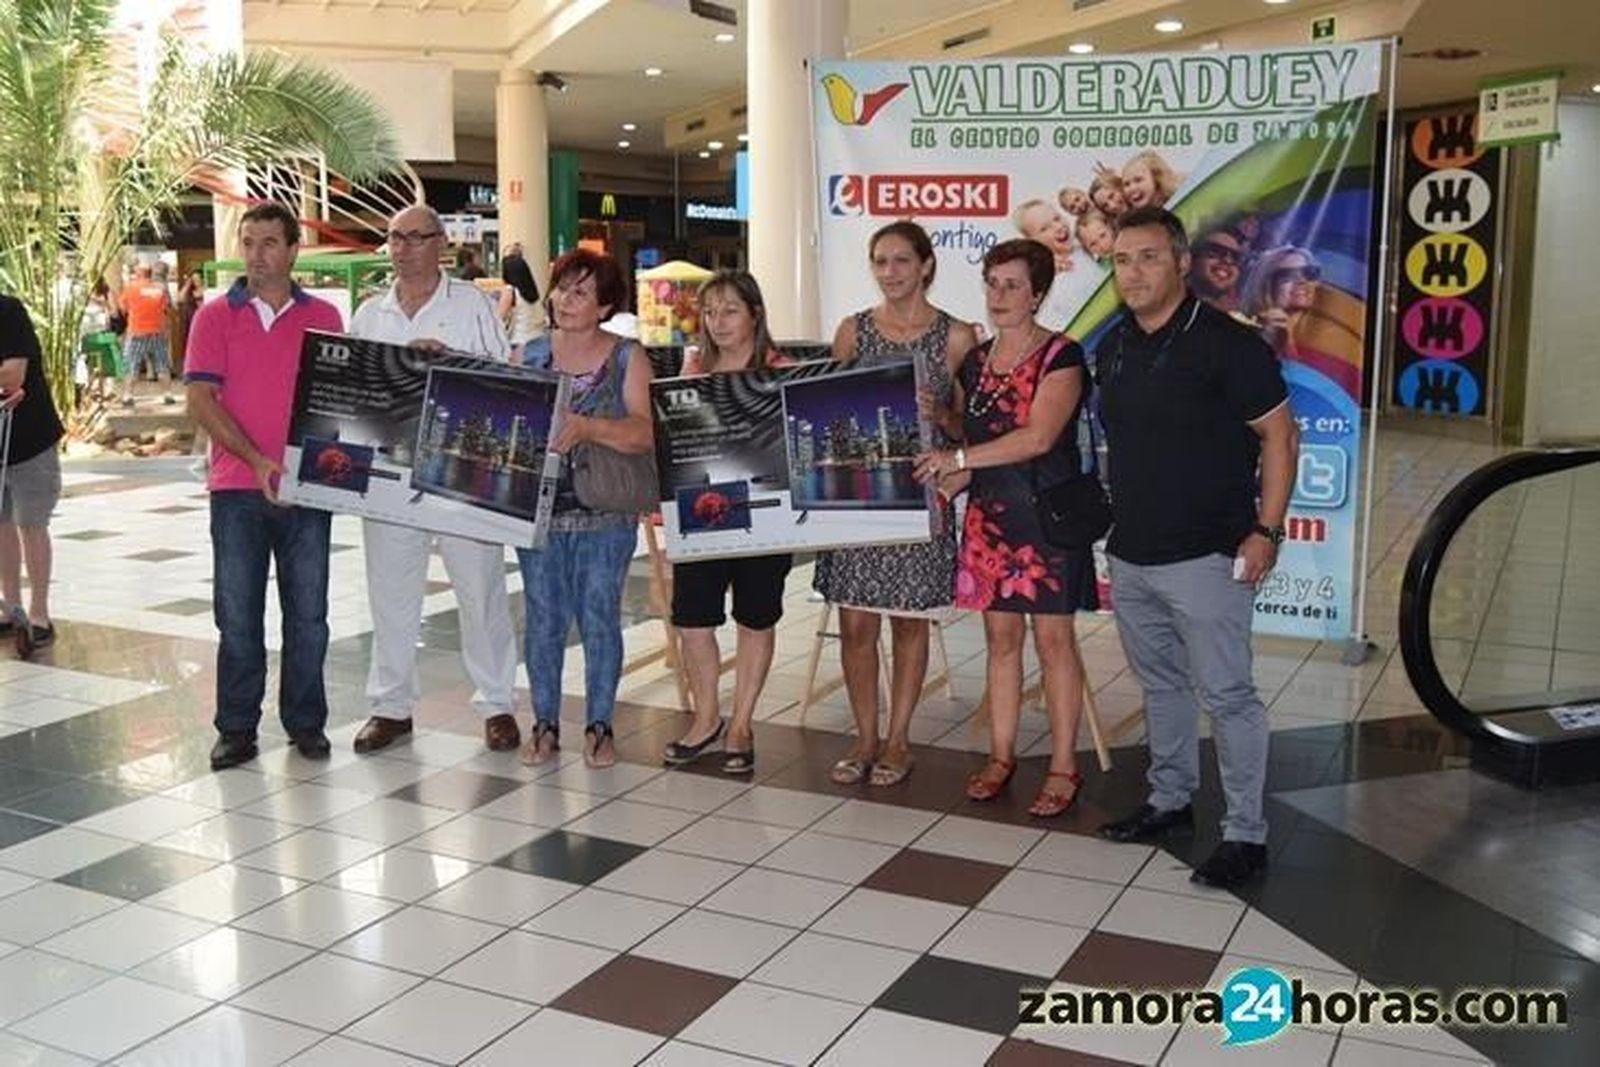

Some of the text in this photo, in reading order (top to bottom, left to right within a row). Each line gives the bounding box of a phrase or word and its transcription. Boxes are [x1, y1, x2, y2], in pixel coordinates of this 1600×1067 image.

[910, 50, 1359, 116] VALDERADUEY
[911, 118, 1359, 148] EL CENTRO COMERCIAL DE ZAMORA
[877, 182, 999, 209] EROSKI
[930, 219, 998, 264] ontigo
[1315, 415, 1350, 433] en:
[1317, 576, 1335, 599] 4
[1255, 602, 1337, 619] cerca de ti
